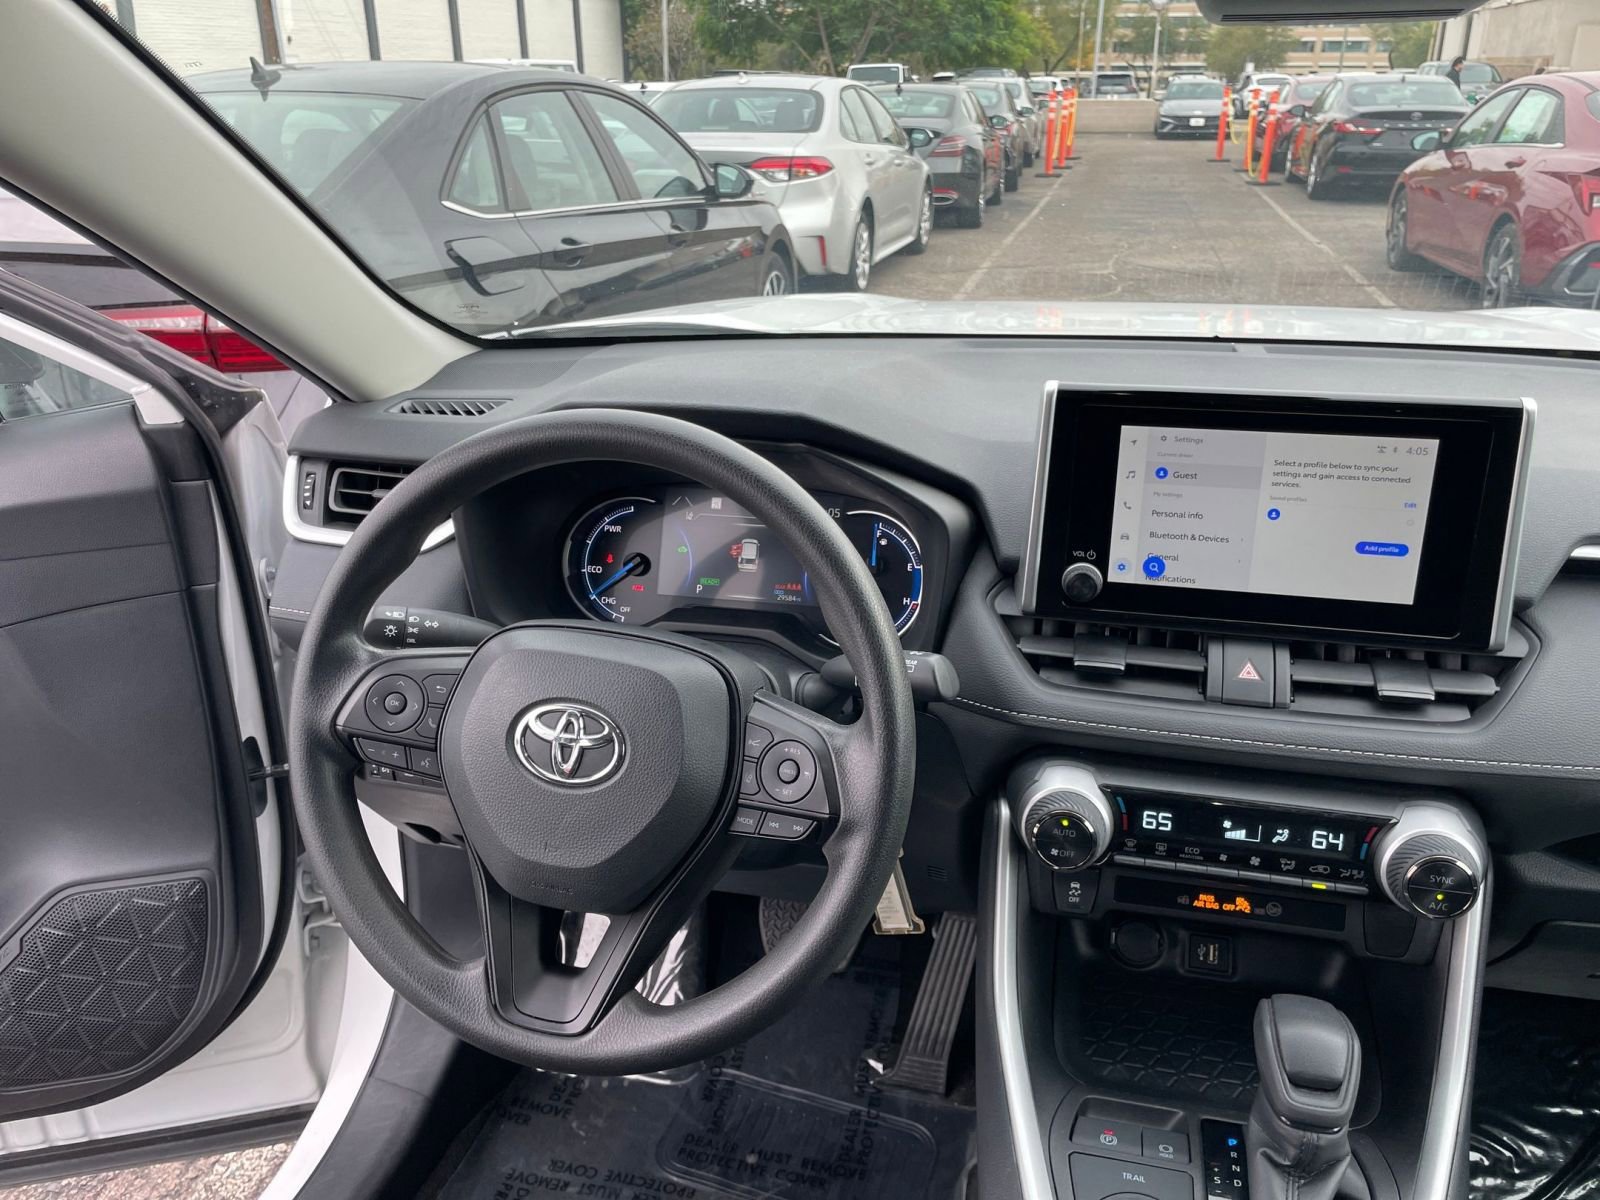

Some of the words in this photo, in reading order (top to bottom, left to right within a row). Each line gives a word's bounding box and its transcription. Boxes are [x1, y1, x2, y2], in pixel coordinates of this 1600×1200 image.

[1174, 435, 1204, 445] Settings
[1406, 446, 1428, 456] 4:05
[1304, 461, 1328, 470] profile
[1329, 462, 1352, 470] below
[1364, 465, 1380, 473] sync
[1172, 471, 1198, 480] Guest
[1272, 471, 1301, 479] settings
[1302, 472, 1317, 480] and
[1318, 472, 1335, 481] gain
[1336, 474, 1360, 482] access
[1371, 476, 1411, 484] connected
[1151, 510, 1186, 519] Personal
[1188, 511, 1204, 520] info
[604, 524, 622, 532] PWR
[876, 530, 882, 538] F
[1150, 531, 1188, 541] Bluetooth
[1198, 534, 1230, 544] Devices
[1148, 553, 1179, 562] Gneral
[907, 564, 912, 572] E
[696, 584, 702, 594] P
[601, 596, 616, 604] CHG
[737, 816, 754, 825] MODE
[1142, 810, 1173, 831] 65
[1052, 828, 1076, 838] AUTO
[1311, 830, 1344, 851] 64
[1059, 850, 1075, 858] OFF
[1184, 846, 1200, 854] ECO
[1429, 874, 1455, 885] SYNC
[1199, 894, 1215, 902] PASS
[1206, 902, 1219, 910] BAG
[1222, 904, 1236, 912] OFF
[1428, 902, 1448, 911] A/C
[495, 1103, 532, 1126] OVER
[856, 1085, 882, 1166] PROTECTIV
[1228, 1138, 1238, 1146] P
[548, 1158, 598, 1180] COVER
[800, 1157, 868, 1181] REMOVE
[1232, 1164, 1240, 1172] N
[504, 1168, 570, 1192] REMOVE
[775, 1169, 828, 1188] COVER
[1122, 1172, 1146, 1183] TRAIL
[1214, 1176, 1221, 1184] S
[604, 1168, 696, 1199] PROTECTIVE
